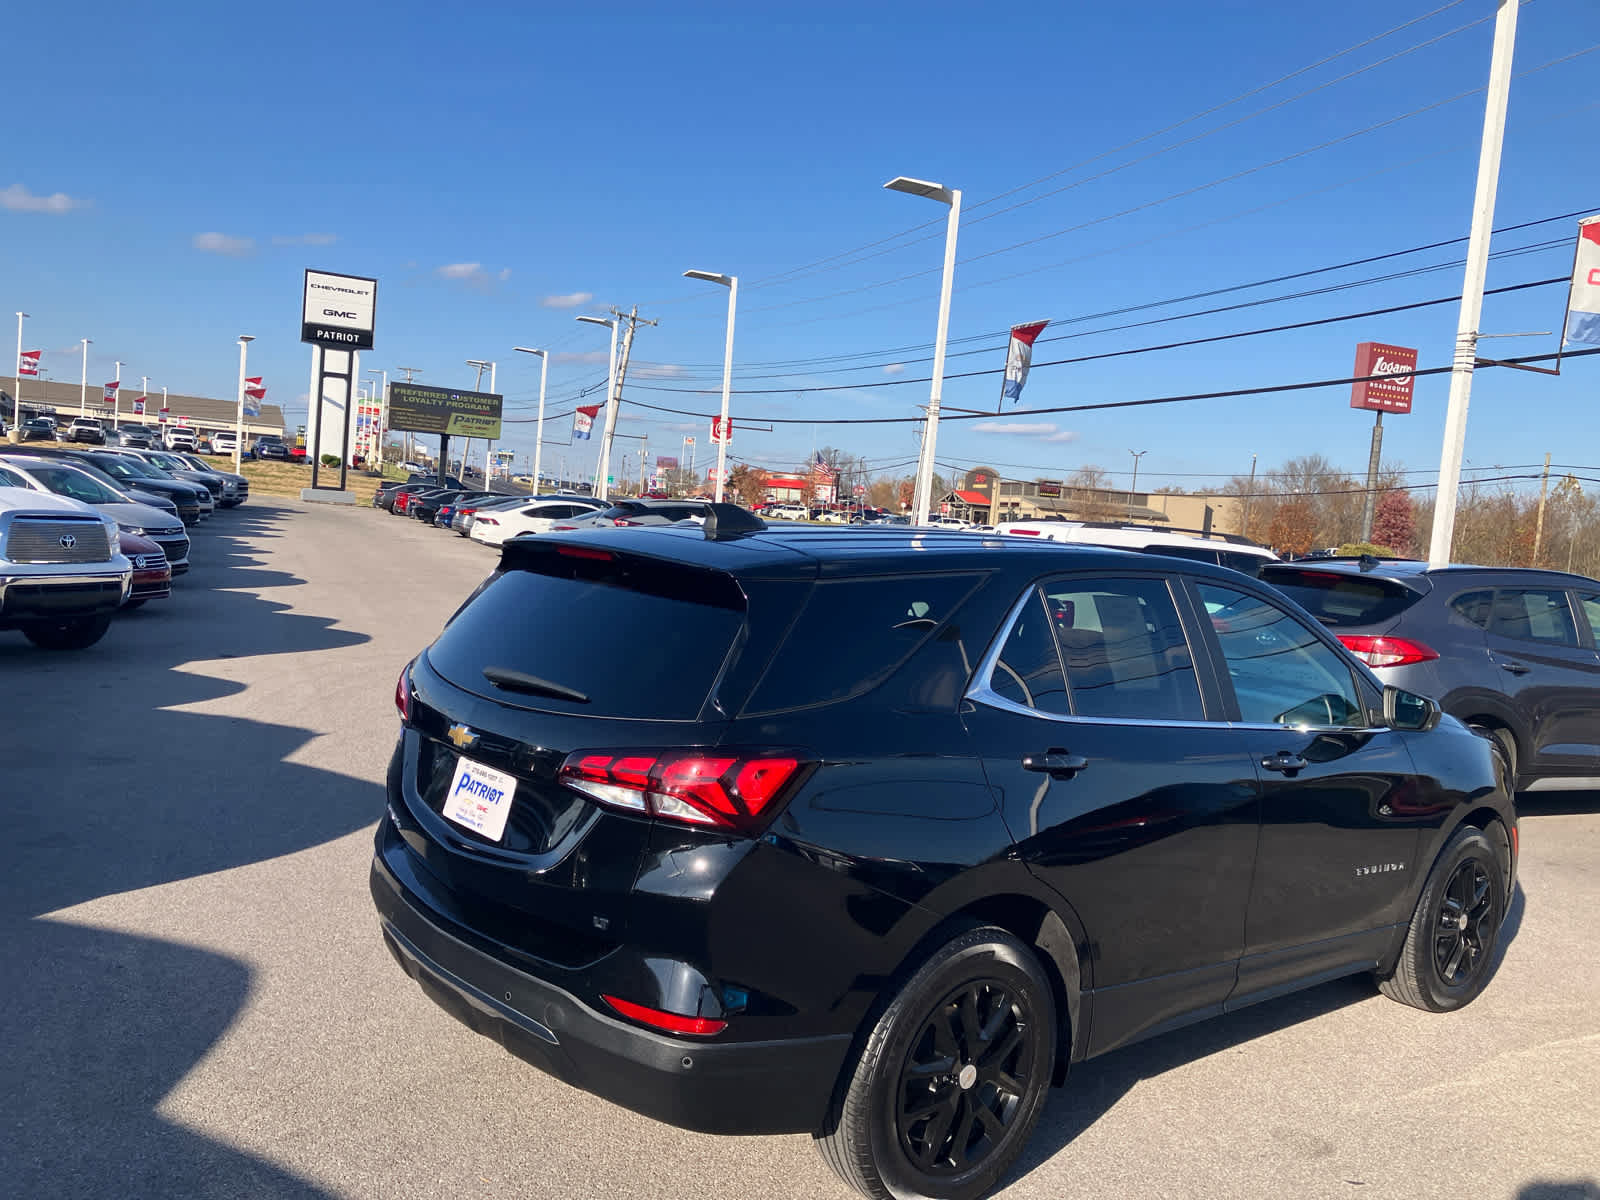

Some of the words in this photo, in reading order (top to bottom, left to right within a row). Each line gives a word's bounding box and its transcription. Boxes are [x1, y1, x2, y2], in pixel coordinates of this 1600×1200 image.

[310, 283, 369, 295] CHEVROLET
[323, 309, 357, 319] GMC
[316, 329, 360, 342] PATRIOT
[394, 387, 448, 400] PREFERRED
[450, 394, 498, 405] CUSTOMER
[403, 395, 443, 407] LOYALTY
[446, 401, 490, 411] PROGRAM
[454, 772, 505, 805] PATRIOT
